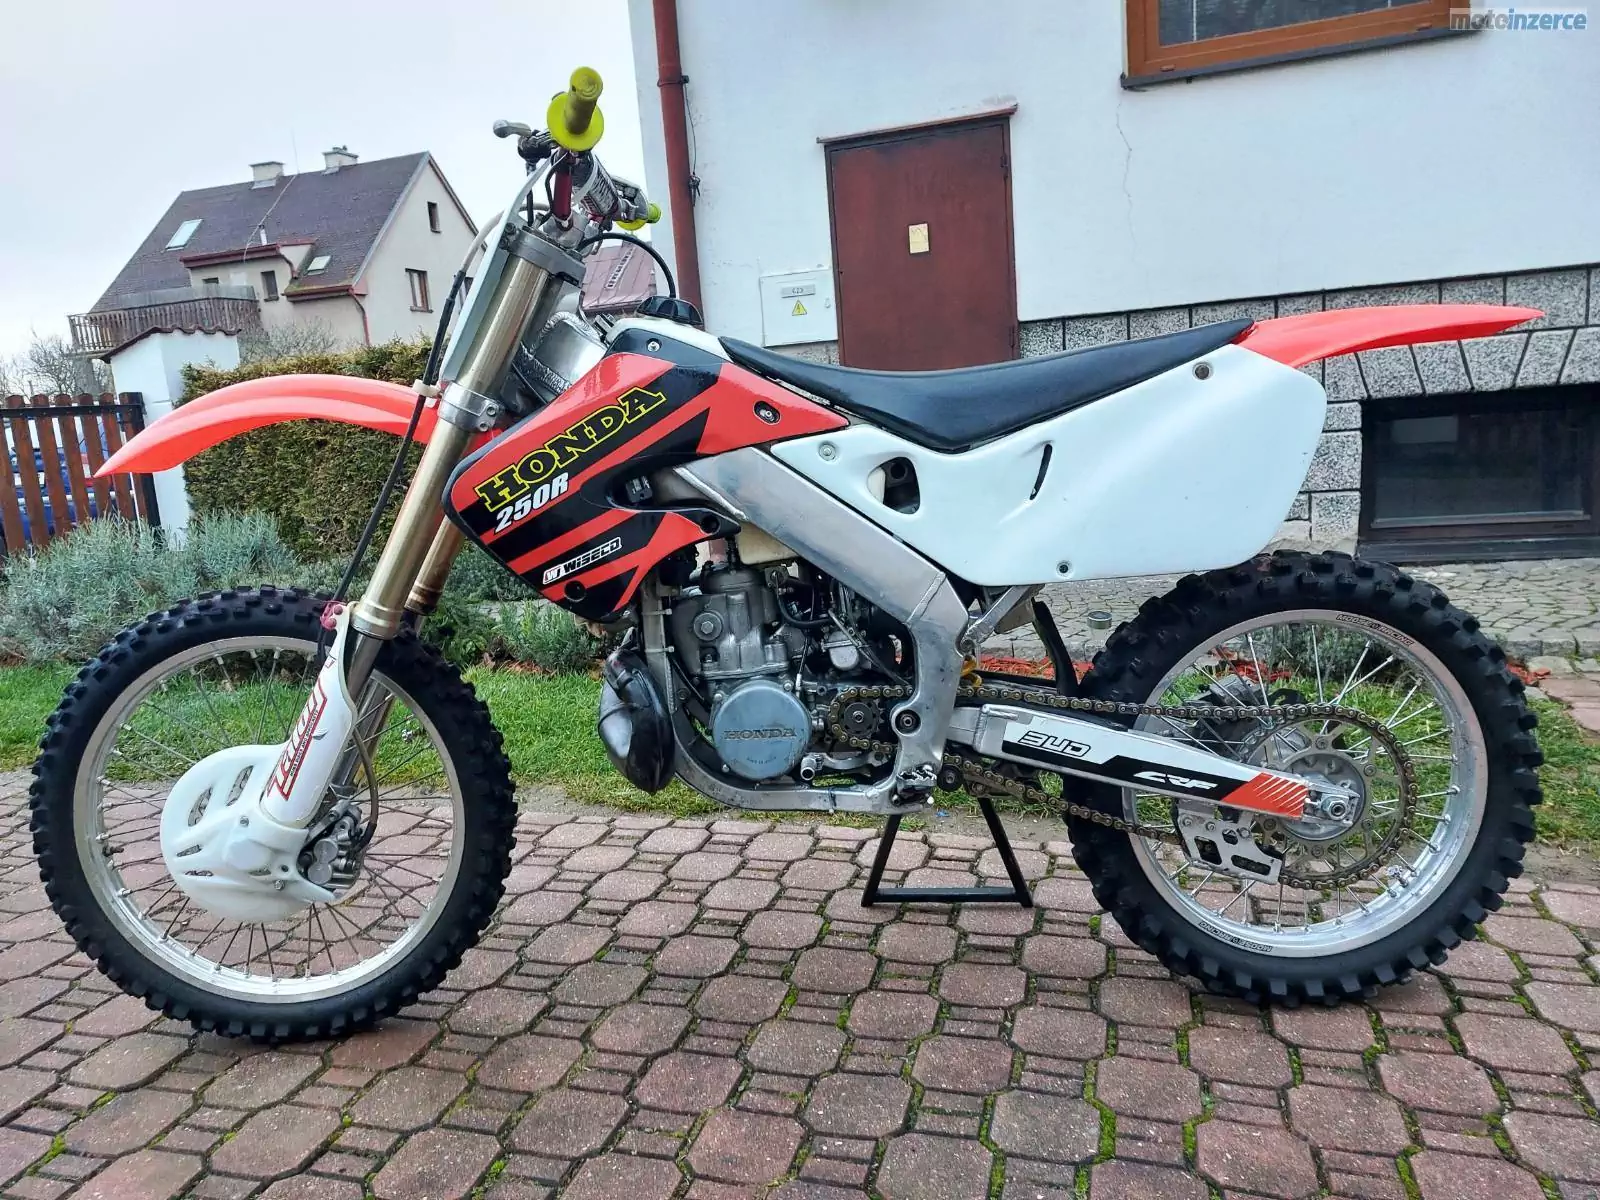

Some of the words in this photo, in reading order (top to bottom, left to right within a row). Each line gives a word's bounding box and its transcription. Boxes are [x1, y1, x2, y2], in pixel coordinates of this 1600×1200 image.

[474, 386, 667, 513] HONDA
[493, 471, 569, 534] 250R
[723, 728, 797, 741] HONDA
[1133, 770, 1219, 790] CRF
